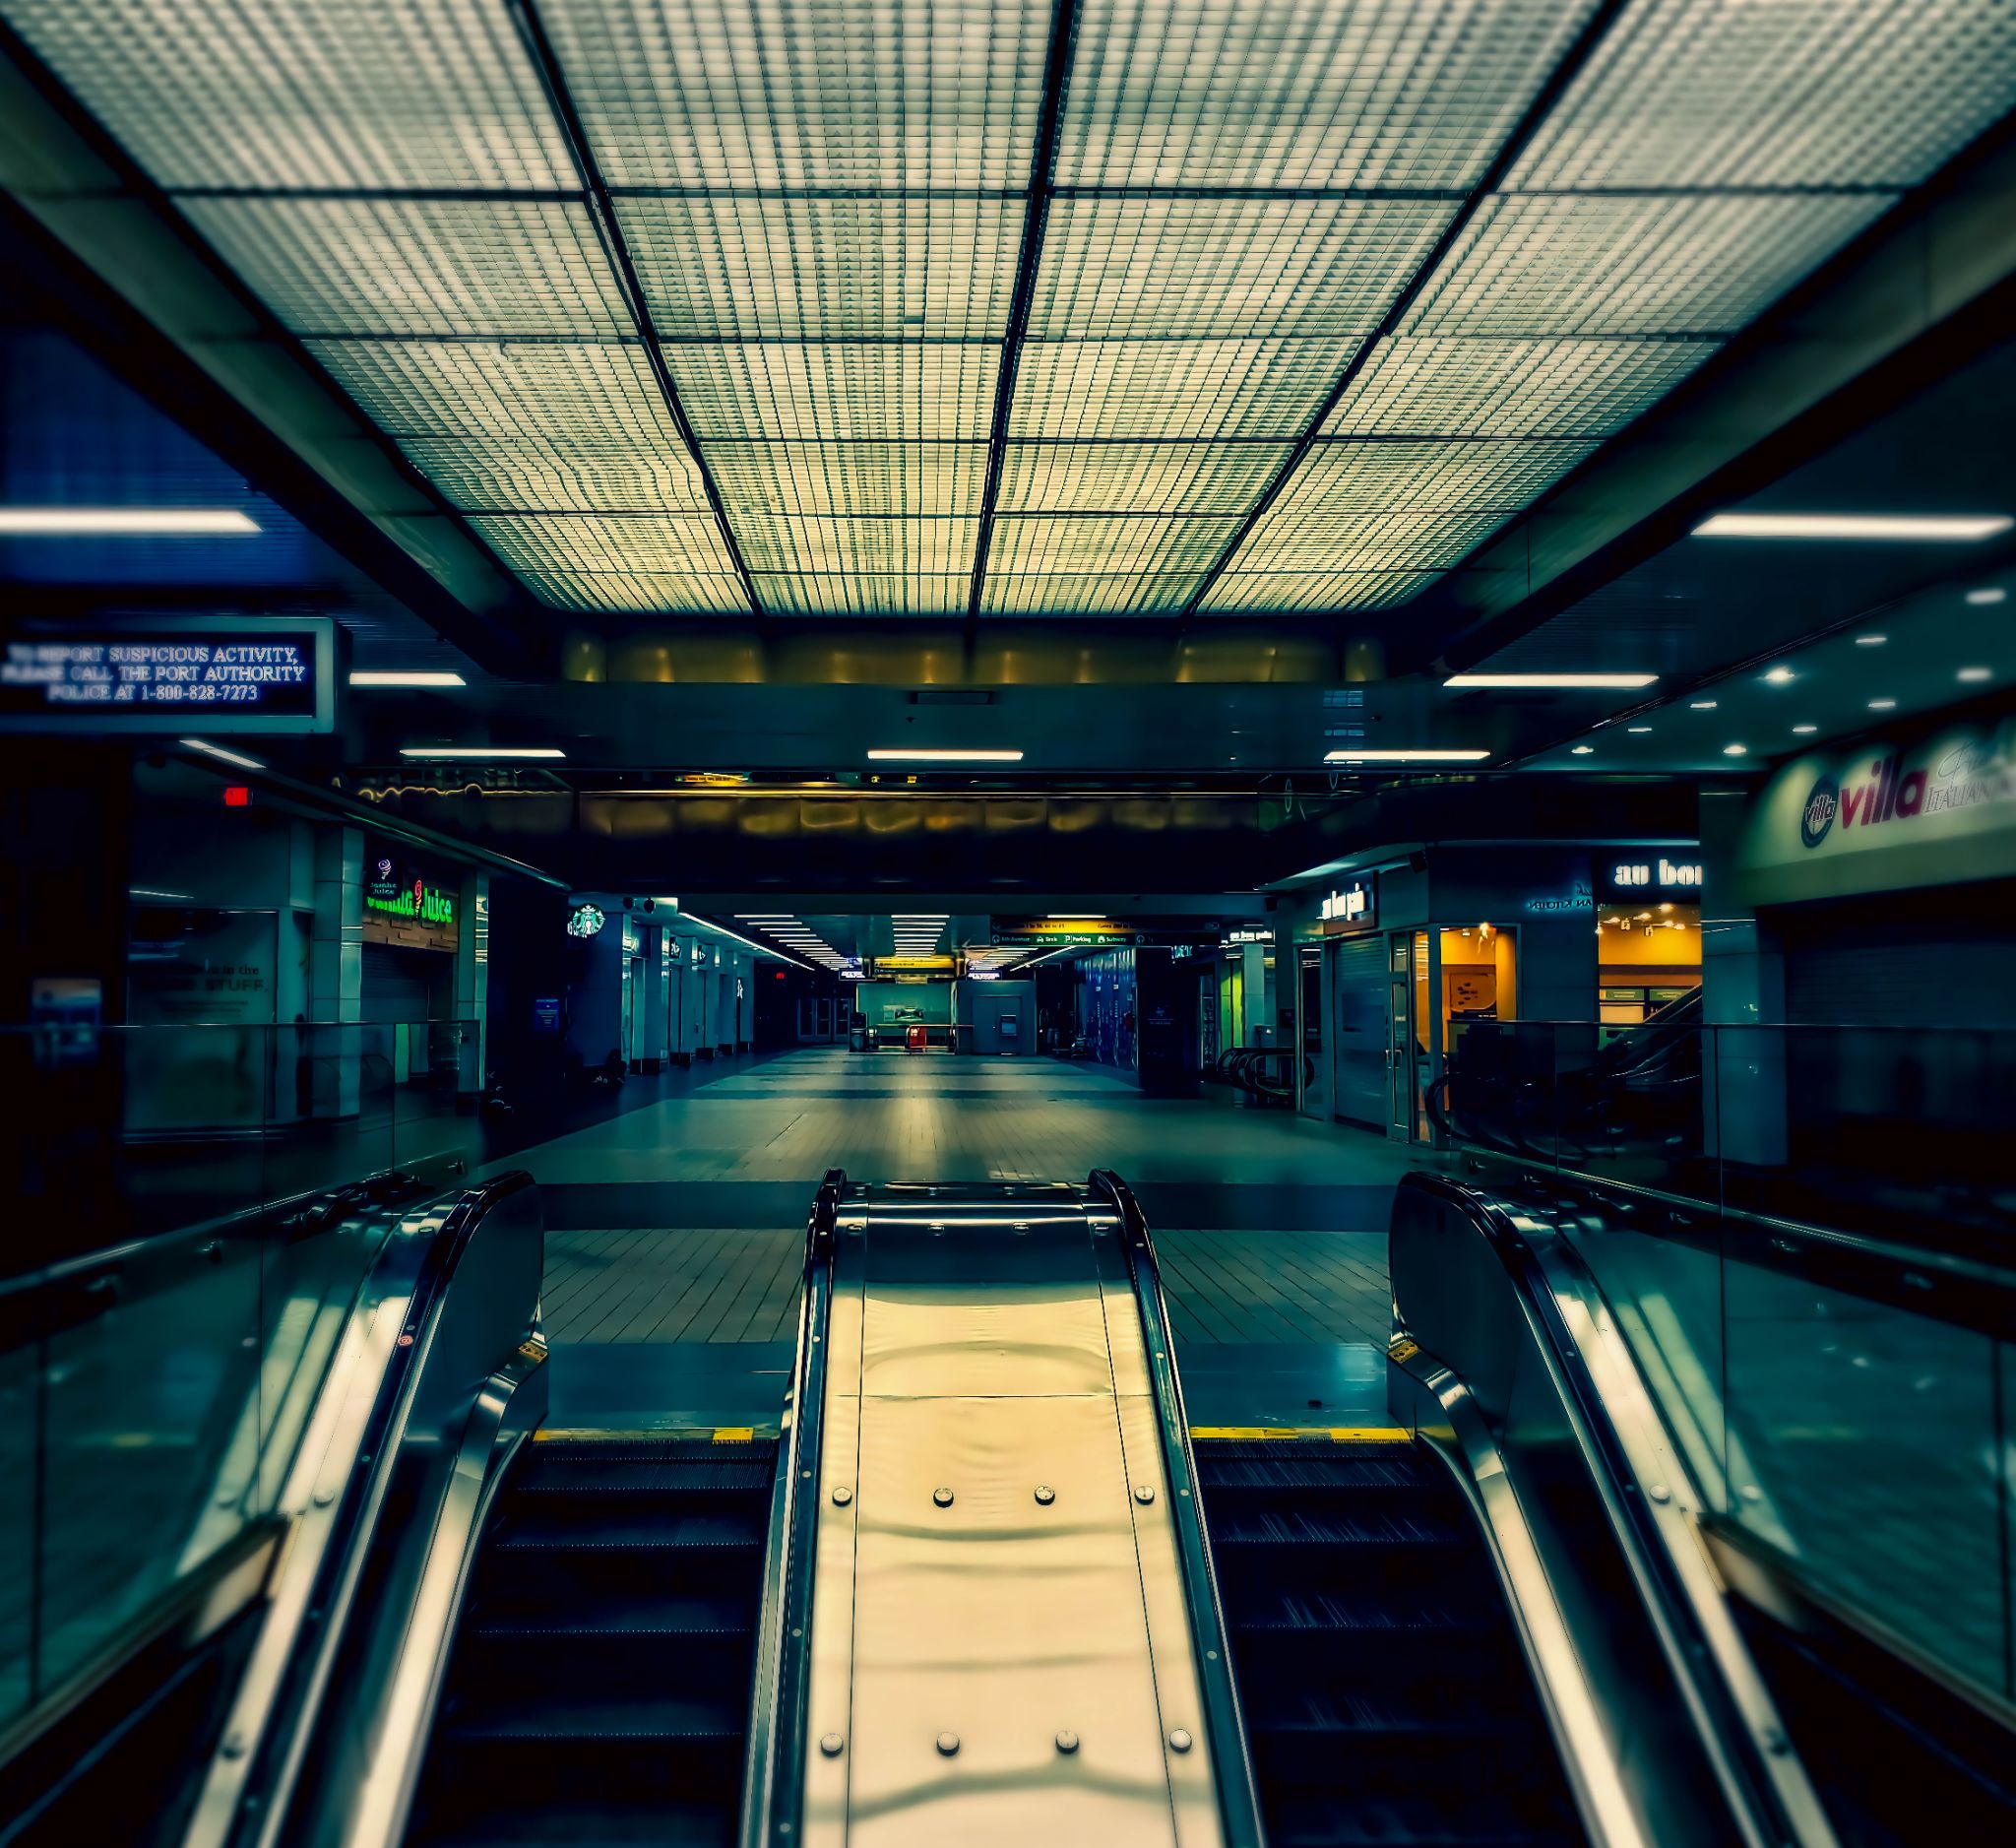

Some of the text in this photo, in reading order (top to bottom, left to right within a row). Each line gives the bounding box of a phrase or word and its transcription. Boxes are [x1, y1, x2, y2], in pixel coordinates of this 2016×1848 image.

[109, 647, 209, 663] SUSPICIOUS
[213, 647, 297, 665] ACTIVITY,
[70, 666, 113, 680] CALL
[118, 666, 152, 680] THE
[155, 666, 198, 680] PORT
[204, 666, 305, 681] AUTHORITY
[48, 685, 258, 700] POLICE AT 1-800-828-7273
[1841, 753, 1928, 829] villa
[1614, 865, 1649, 885] au
[421, 887, 452, 924] Juice
